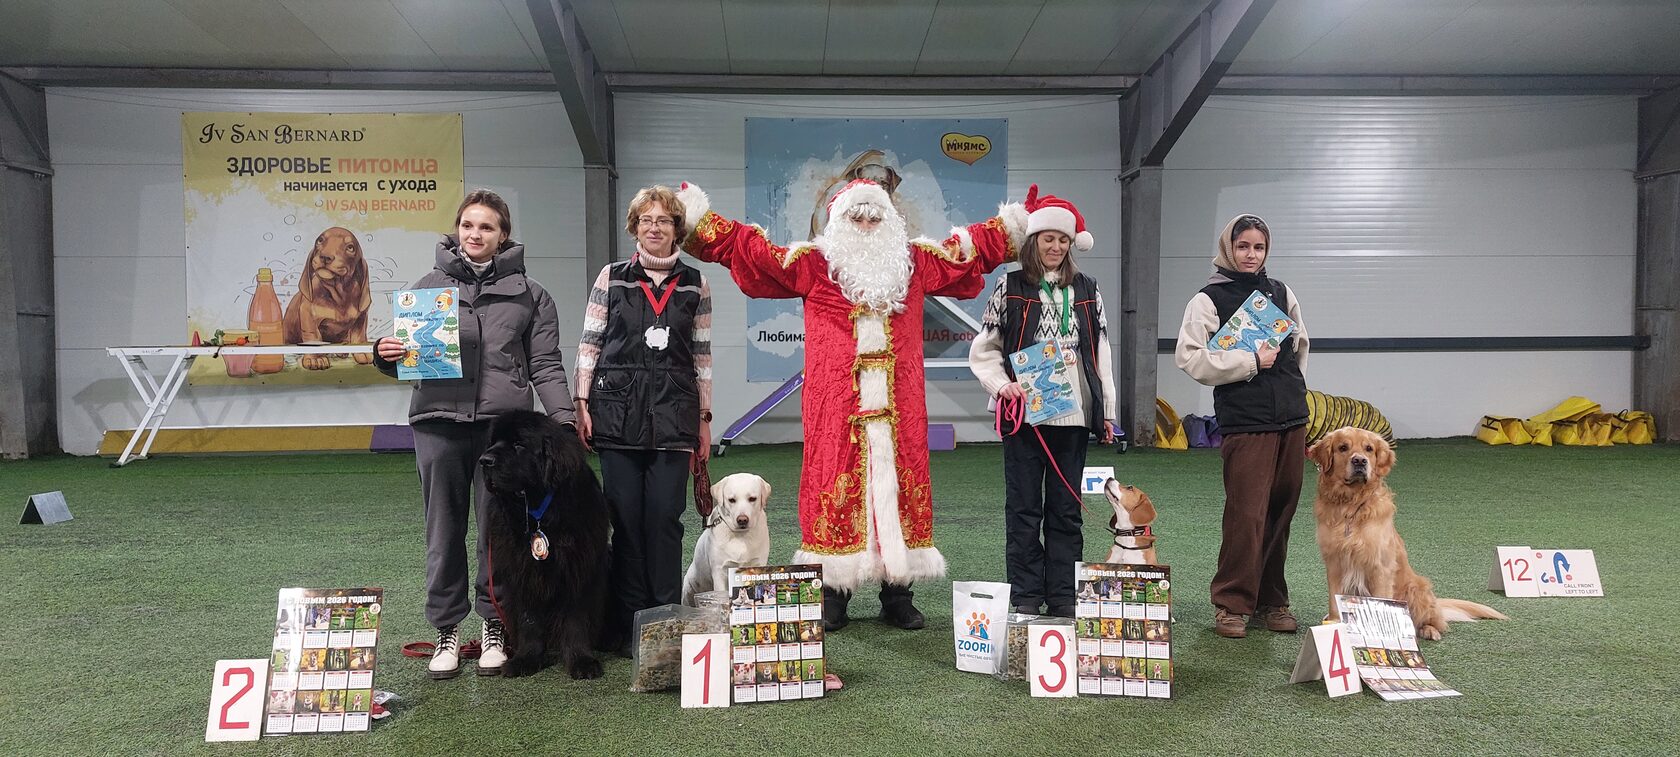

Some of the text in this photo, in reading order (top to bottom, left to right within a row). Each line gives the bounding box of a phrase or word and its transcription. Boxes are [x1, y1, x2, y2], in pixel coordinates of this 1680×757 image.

[226, 157, 332, 176] ЗДОРОВЬЕ
[283, 179, 437, 194] начинается с ухода
[326, 200, 436, 211] IV SAN BERNARD
[757, 330, 805, 342] Любим
[952, 331, 974, 342] соб
[1503, 558, 1533, 582] 12
[327, 596, 346, 604] 2026
[348, 595, 377, 604] ГОДОМ!
[1039, 629, 1067, 693] 3
[1328, 629, 1350, 691] 4
[693, 639, 711, 704] 1
[219, 667, 254, 729] 2
